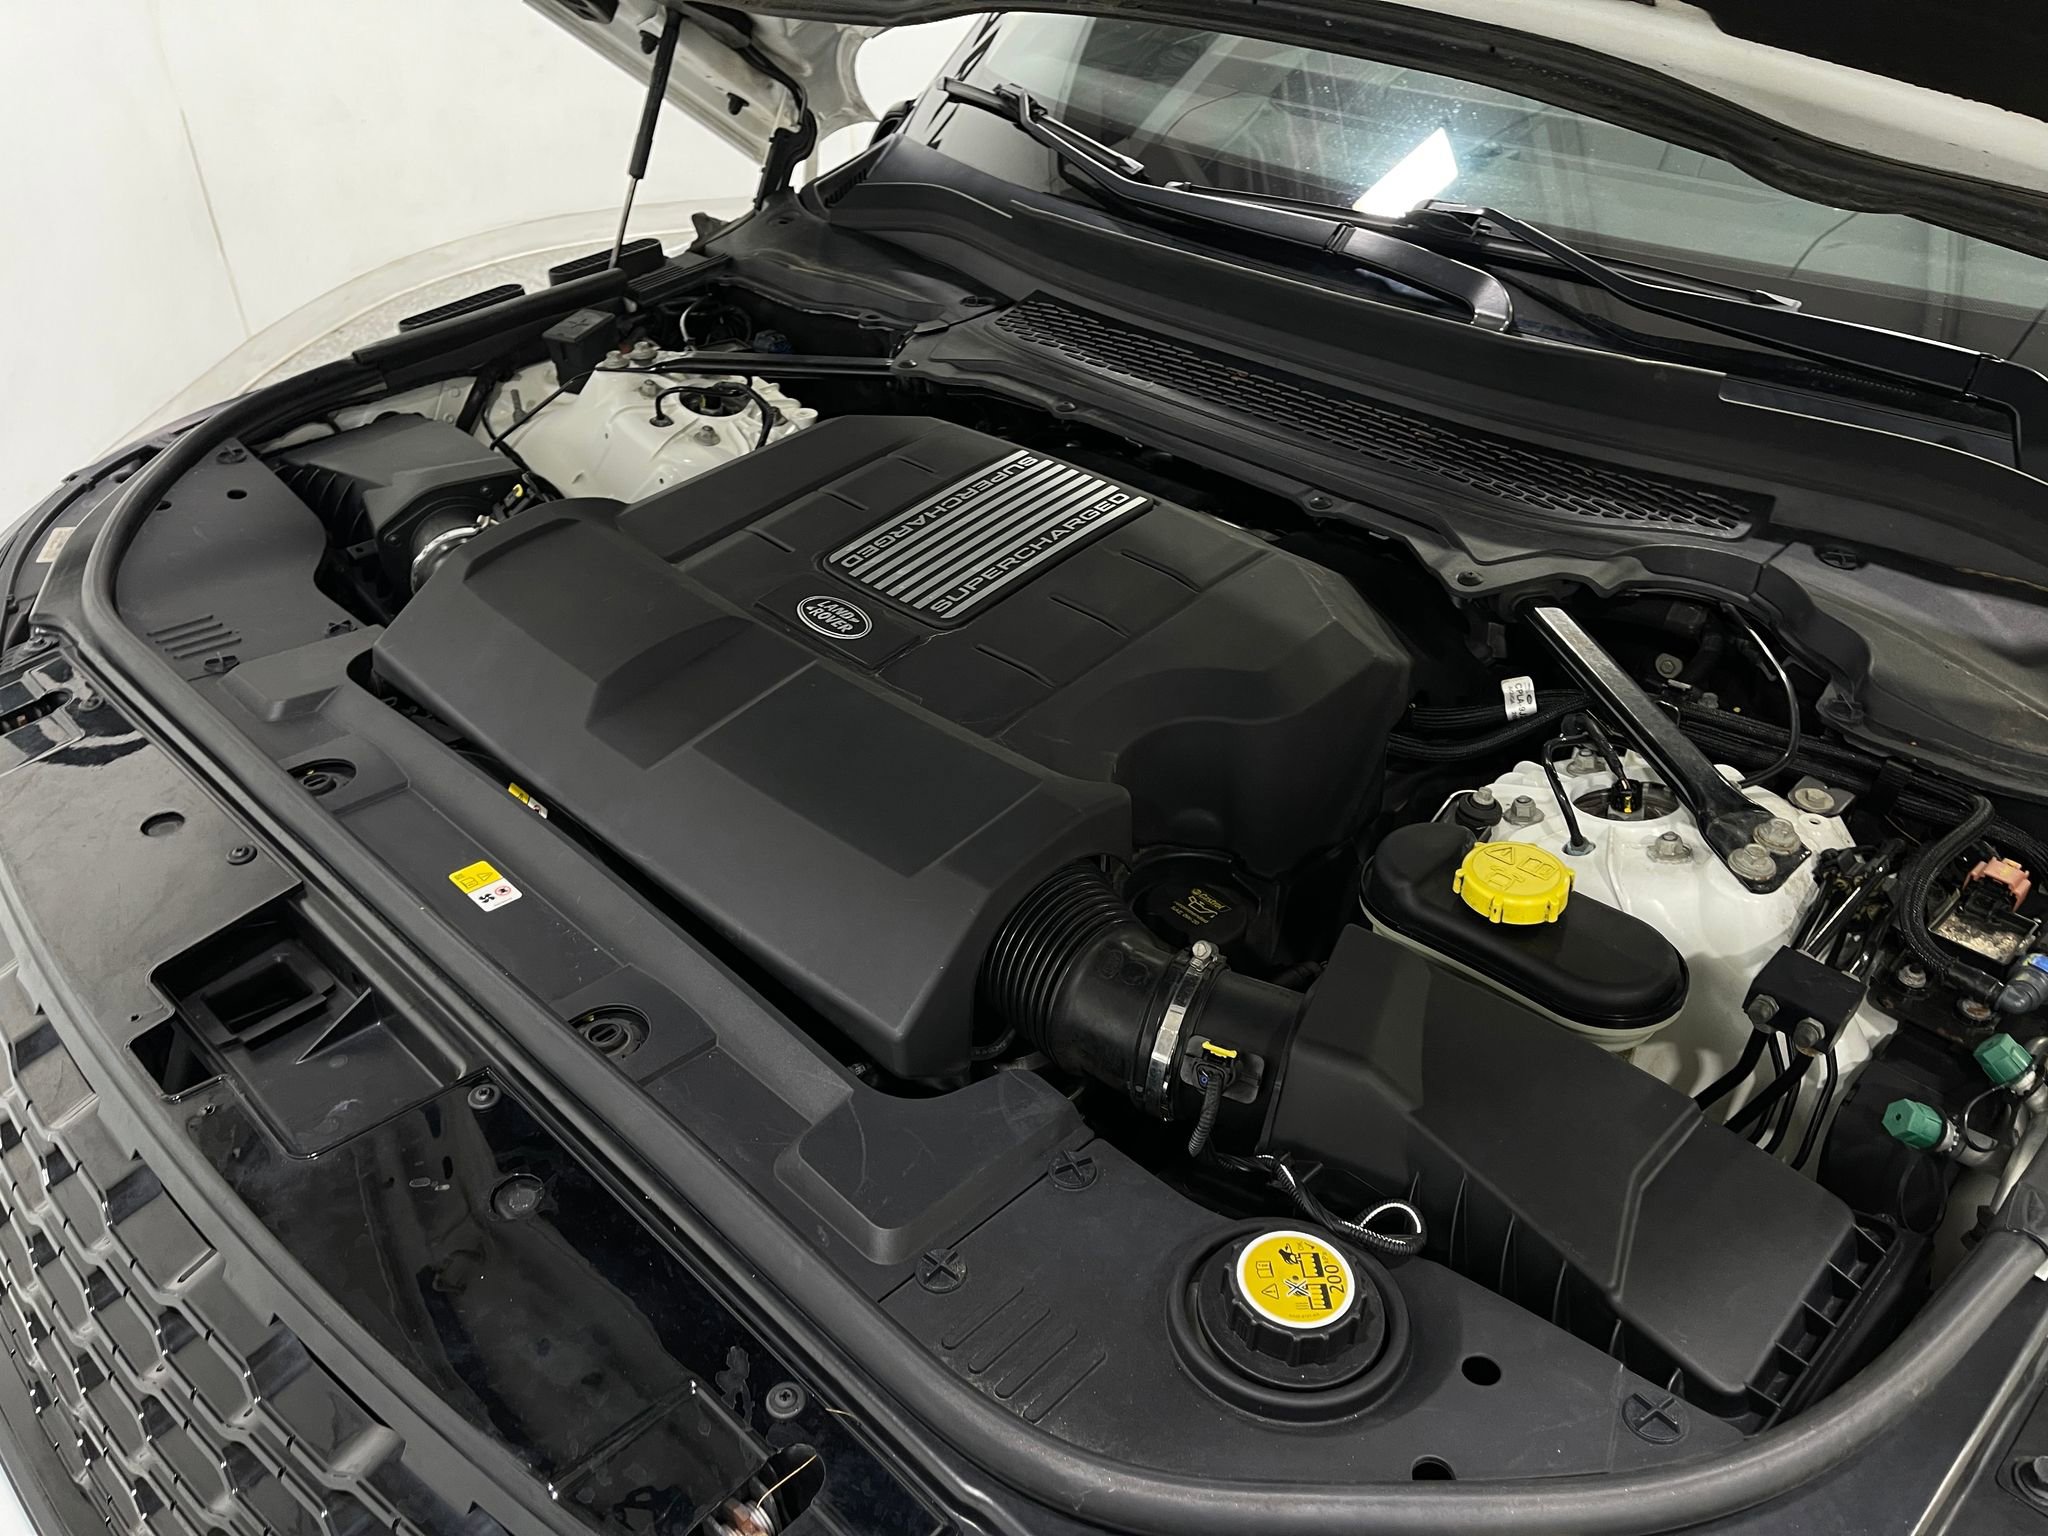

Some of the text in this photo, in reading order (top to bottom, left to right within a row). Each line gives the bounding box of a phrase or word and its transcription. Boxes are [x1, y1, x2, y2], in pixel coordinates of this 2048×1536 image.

[841, 455, 1040, 569] SUPERCHARGED
[930, 492, 1130, 613] SUPERCHARGED
[808, 608, 854, 633] ROVER
[817, 600, 855, 619] LAND
[1324, 1264, 1345, 1293] 200
